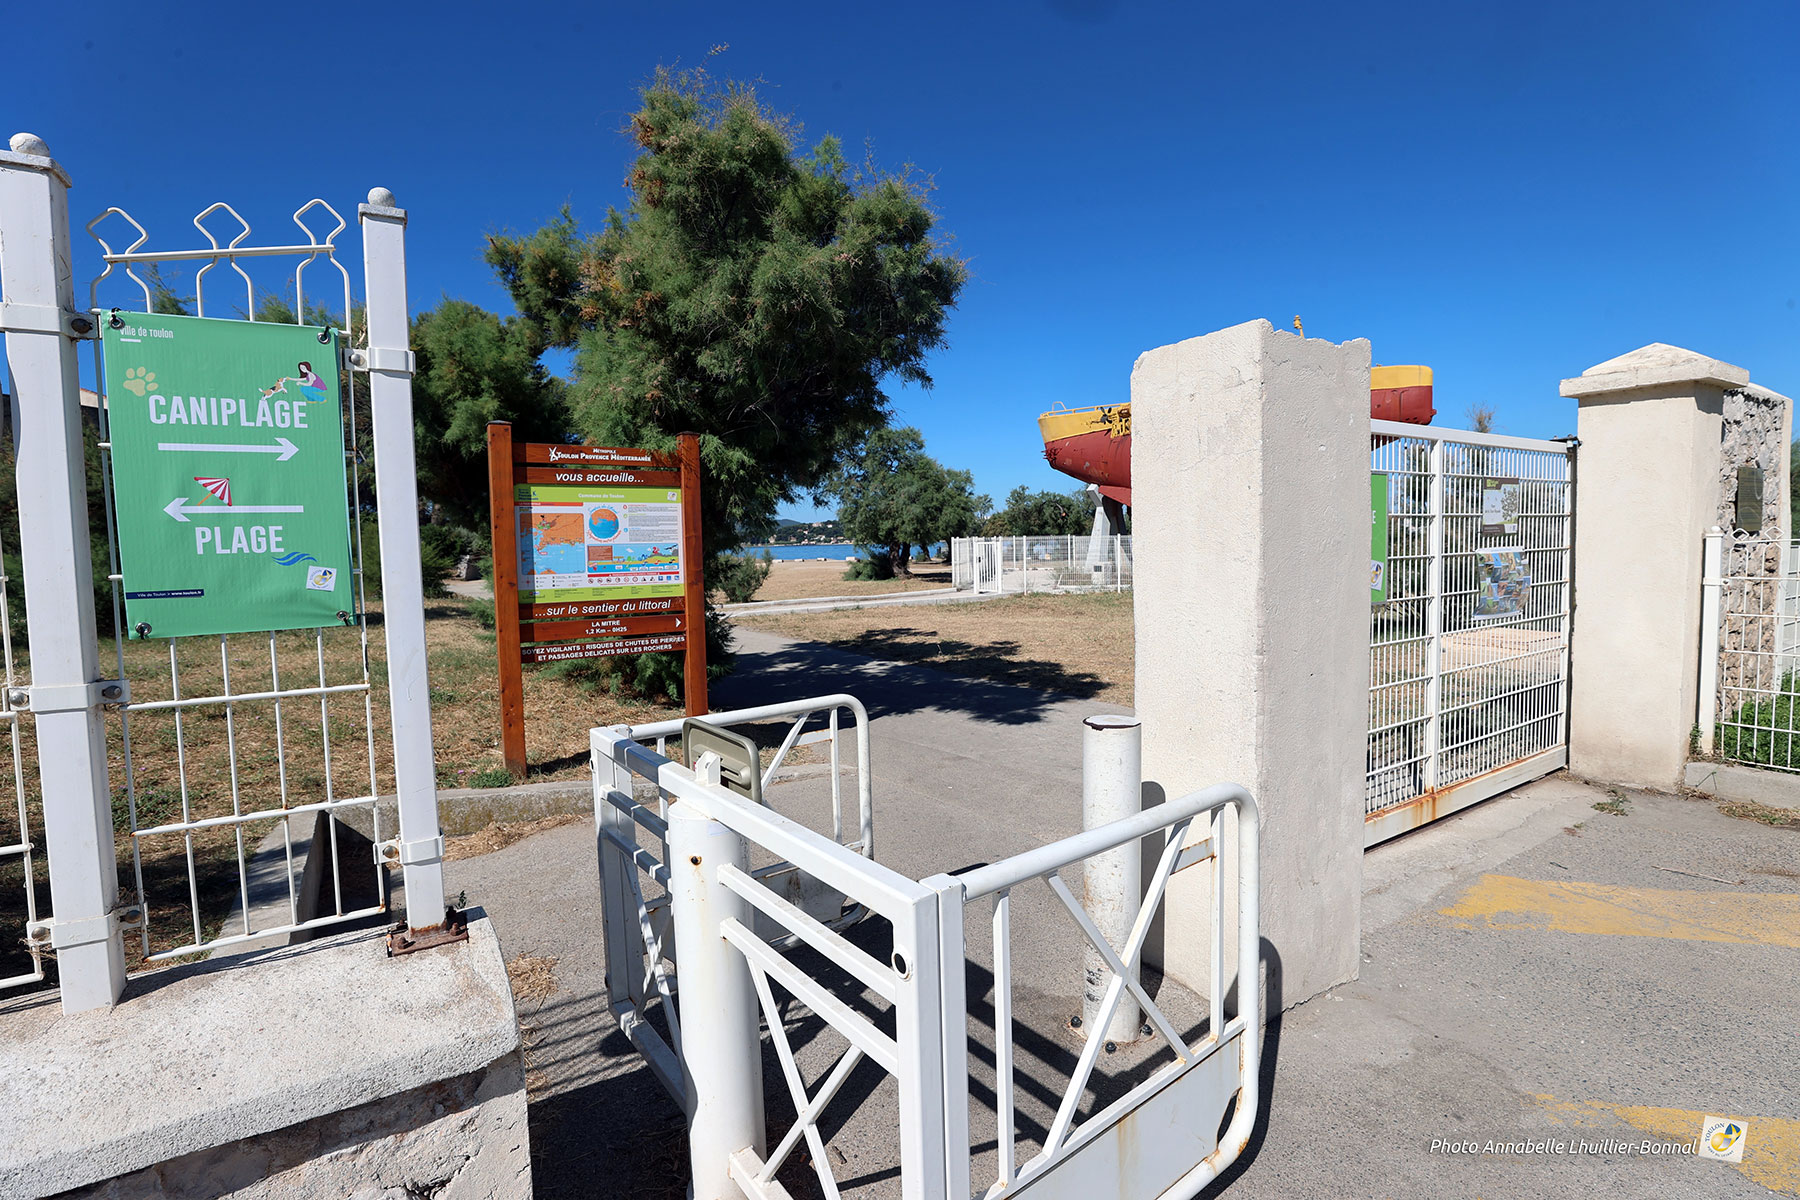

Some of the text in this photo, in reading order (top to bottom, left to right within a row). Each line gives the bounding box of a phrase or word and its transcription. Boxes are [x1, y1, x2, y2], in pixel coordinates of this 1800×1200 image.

[138, 326, 147, 337] de
[149, 394, 308, 429] CANIPLAGE
[555, 472, 644, 483] vous accueille...
[195, 525, 284, 555] PLAGE
[535, 599, 672, 617] ...sur le sentier du littoral
[546, 645, 581, 654] VIGILANTS
[586, 642, 614, 650] RISQUES
[625, 639, 649, 647] CHUTES
[548, 651, 583, 660] PASSAGES
[643, 644, 672, 652] ROCHERS
